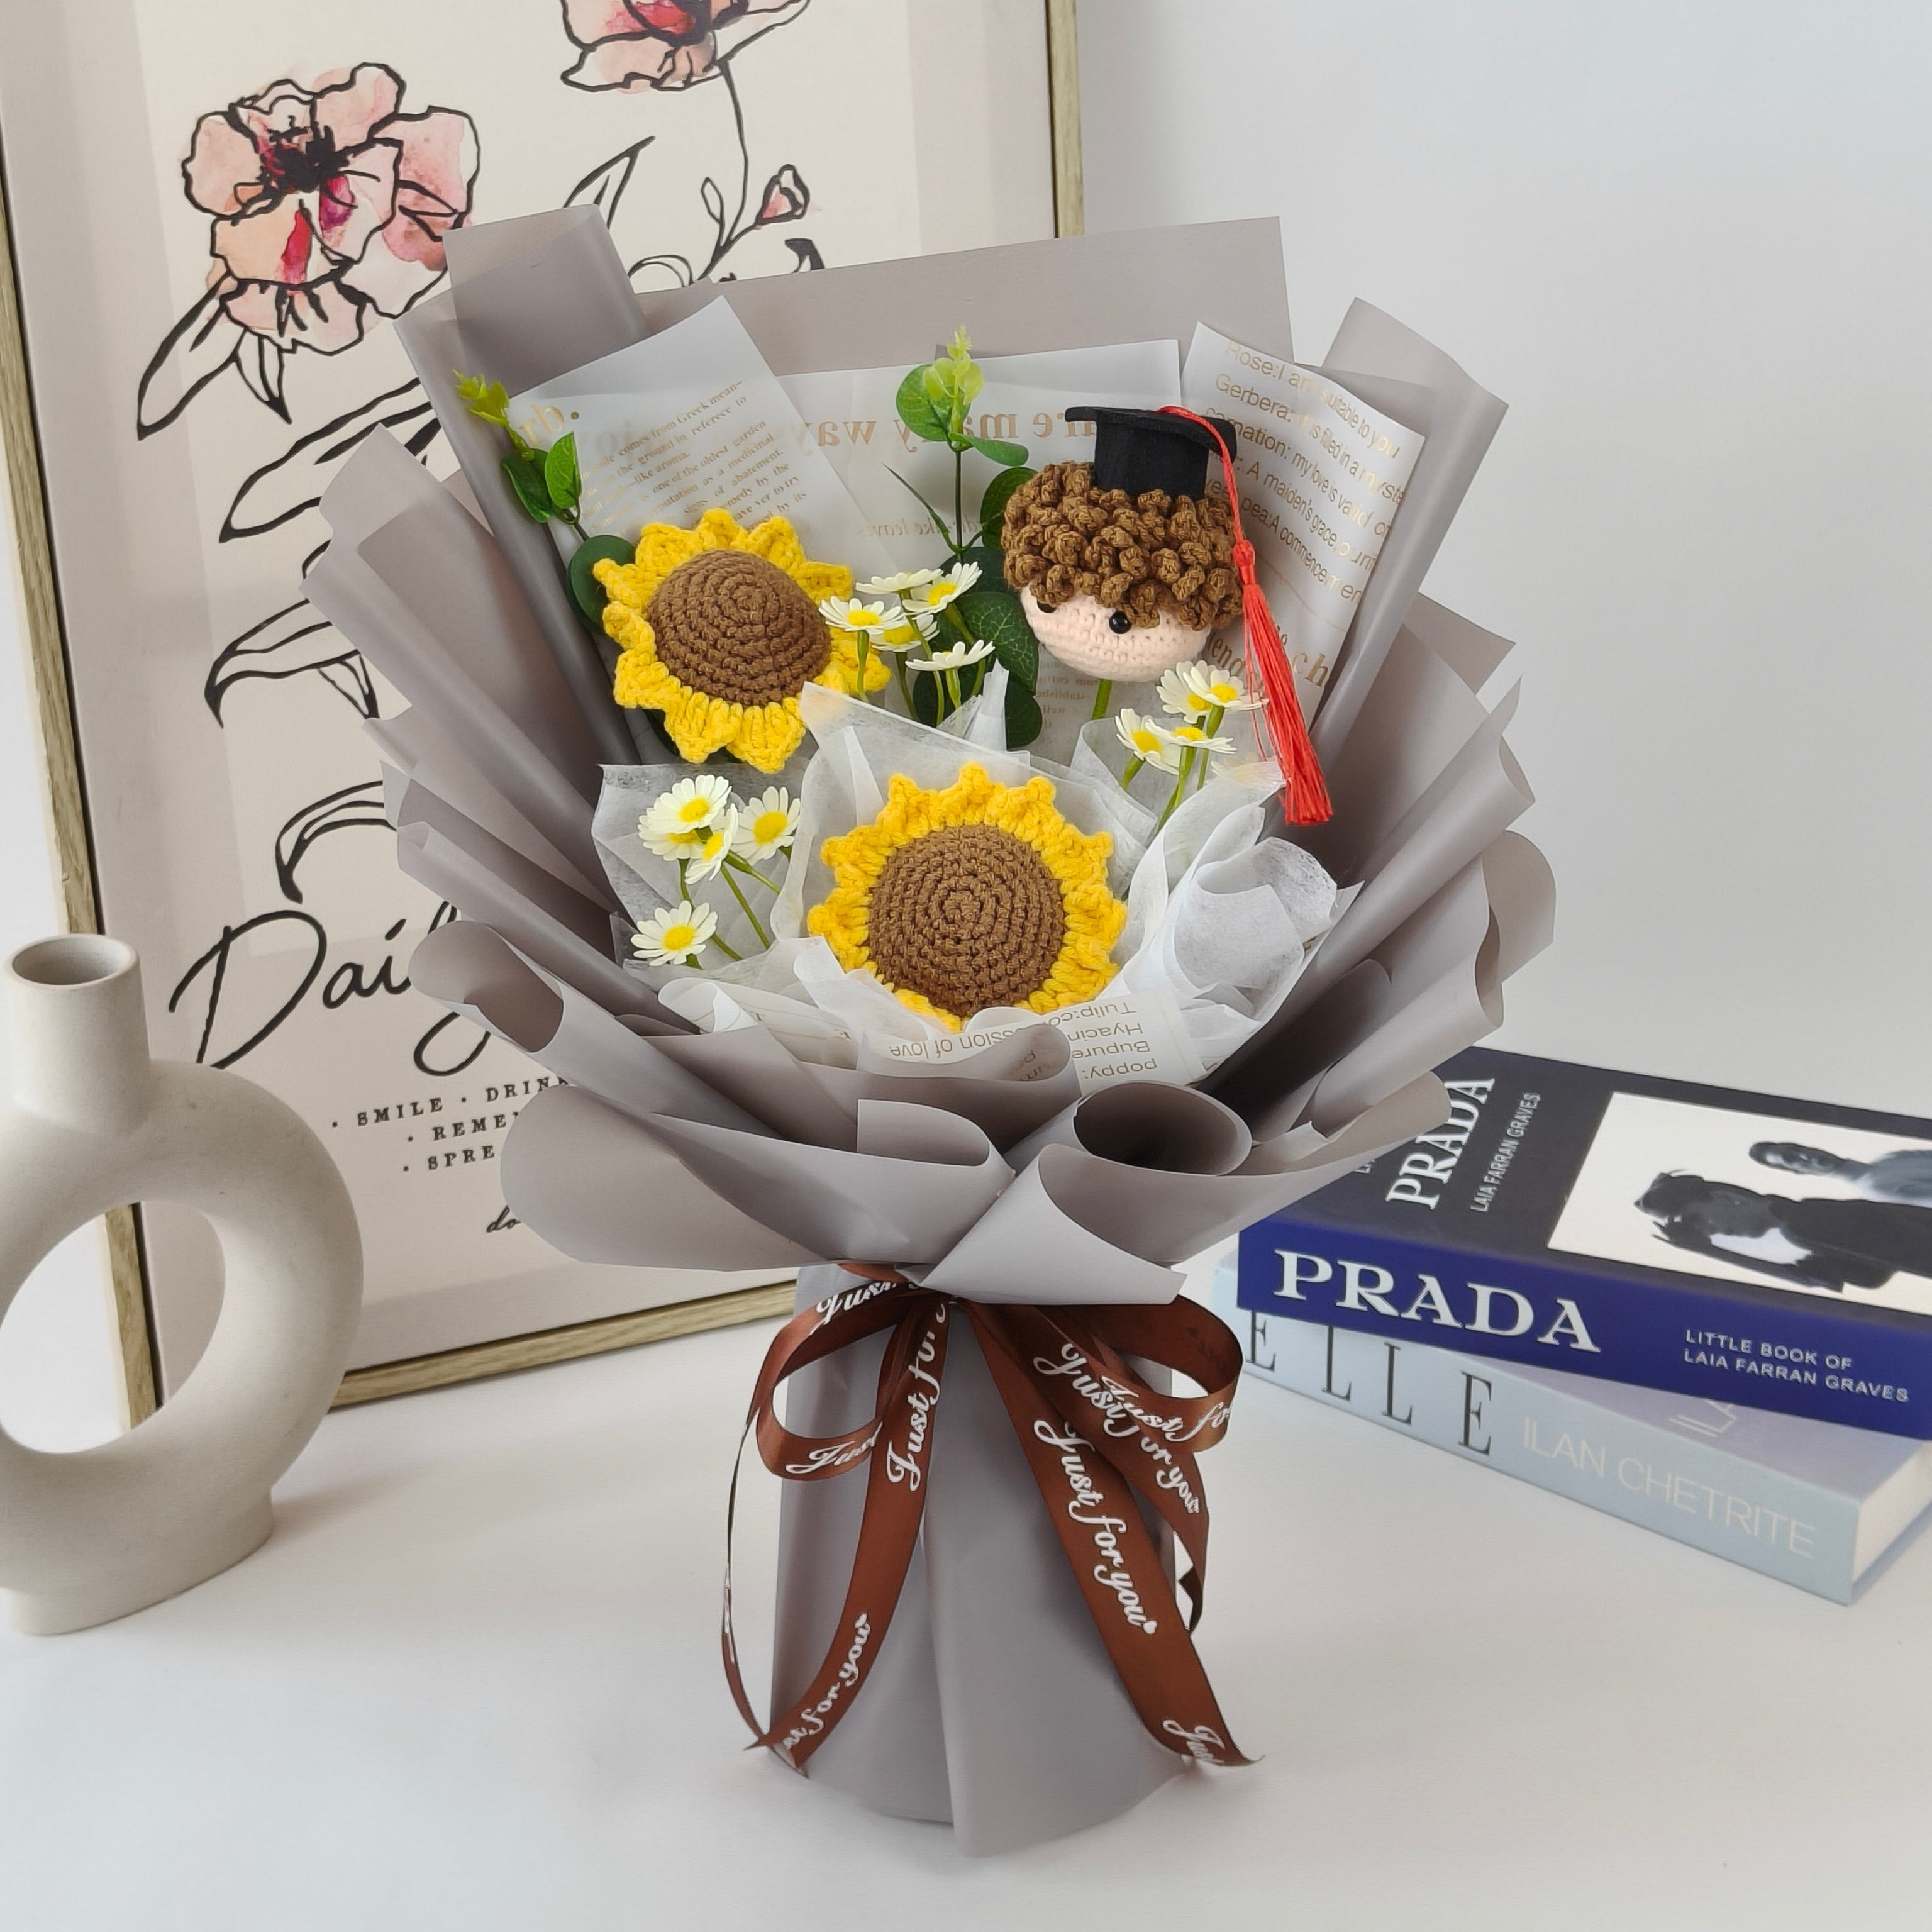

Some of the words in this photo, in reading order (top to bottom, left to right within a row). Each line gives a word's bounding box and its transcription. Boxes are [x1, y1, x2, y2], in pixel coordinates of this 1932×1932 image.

[735, 396, 747, 406] to
[1358, 418, 1370, 438] to
[671, 472, 682, 483] of
[682, 464, 699, 477] the
[773, 486, 784, 495] to
[1349, 461, 1359, 477] a
[935, 1038, 953, 1058] of
[1081, 1058, 1158, 1079] poppy:
[357, 1097, 444, 1127] SMILE
[433, 1111, 520, 1141] REME
[1385, 1078, 1496, 1211] PRADA
[1470, 1184, 1500, 1213] LAIA
[1506, 1092, 1541, 1139] GRAVES
[1272, 1248, 1602, 1354] PRADA
[1685, 1328, 1753, 1354] LITTLE
[1760, 1341, 1818, 1366] BOOK
[1824, 1354, 1854, 1370] OF
[1684, 1348, 1729, 1370] LAIA
[1735, 1357, 1818, 1385] FARRAN
[1824, 1374, 1911, 1403] GRAVES
[887, 1392, 931, 1492] Just
[1033, 1419, 1104, 1507] Just
[1523, 1416, 1606, 1479] ILAN
[1618, 1456, 1817, 1560] CHETRITE
[1068, 1499, 1127, 1568] for
[1092, 1563, 1148, 1627] you
[801, 1681, 841, 1735] for
